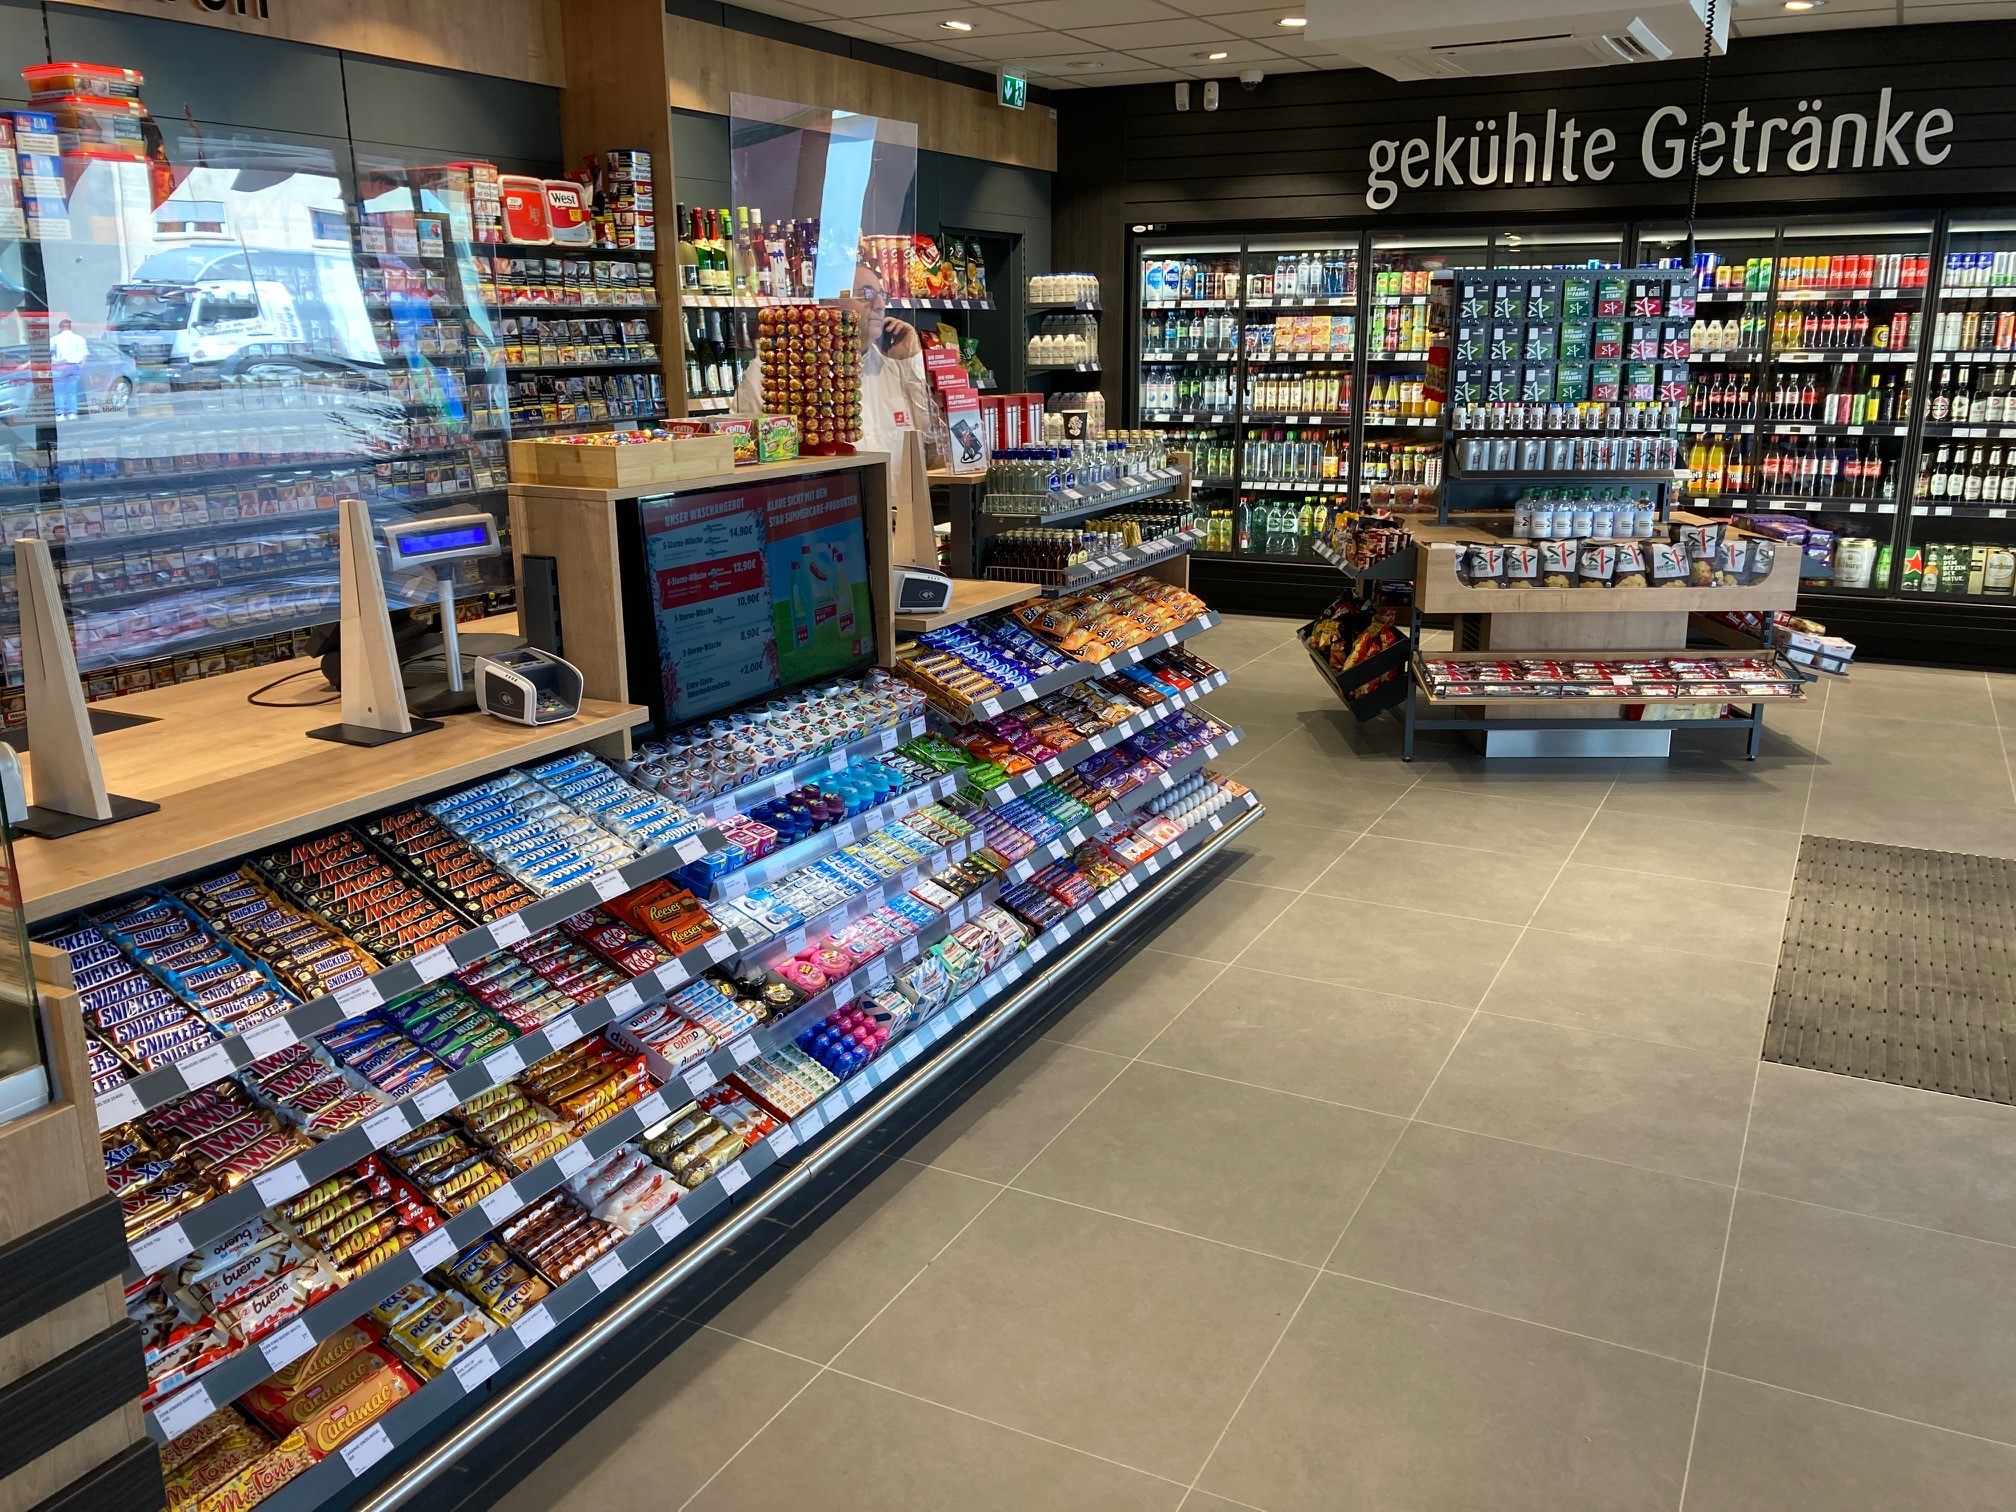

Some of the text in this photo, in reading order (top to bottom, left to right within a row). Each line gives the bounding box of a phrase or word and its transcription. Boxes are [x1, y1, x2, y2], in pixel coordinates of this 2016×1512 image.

[1366, 87, 1954, 210] gekühlte Getränke
[550, 191, 577, 206] West
[725, 424, 747, 434] CENTER
[665, 497, 745, 527] UNSER WASCHANGEBOT
[767, 487, 828, 512] KLARE SICHT MIT DEN
[729, 524, 753, 538] 14,90€
[769, 513, 785, 528] STAR
[733, 559, 757, 573] 12,90€
[737, 592, 760, 607] 10,90€
[565, 772, 607, 794] BOUNTY
[577, 780, 618, 804] BOUNTY
[461, 804, 515, 829] BOUNTY
[475, 813, 527, 838] BOUNTY
[636, 812, 681, 838] BOUNTY
[491, 822, 545, 848] BOUNTY
[508, 831, 560, 855] BOUNTY
[659, 820, 699, 843] BOUNTY
[303, 840, 364, 877] Mars
[436, 851, 479, 879] Mars
[516, 840, 570, 865] BOUNTY
[202, 872, 240, 893] SNICKERS
[334, 863, 395, 901] Mars
[450, 860, 492, 889] Mars
[541, 857, 594, 882] BOUNTY
[229, 899, 267, 923] SNICKERS
[347, 878, 406, 915] Mars
[365, 886, 424, 925] Mars
[481, 883, 524, 911] Mars
[650, 901, 681, 921] Reese's
[136, 918, 189, 945] SNICKERS
[379, 899, 436, 937] Mars
[398, 909, 455, 949] Mars
[568, 909, 595, 933] KitKat
[154, 932, 208, 961] SNICKERS
[599, 926, 627, 950] KitKat
[671, 924, 702, 943] Reese's
[188, 962, 240, 987] SNICKERS
[315, 951, 352, 973] SNICKERS
[628, 948, 656, 972] KitKat
[201, 972, 254, 1003] SNICKERS
[327, 965, 364, 990] SNICKERS
[81, 973, 151, 1013] SNICKERS
[213, 990, 267, 1019] SNICKERS
[100, 988, 175, 1028] SNICKERS
[135, 1018, 206, 1059] SNICKERS
[611, 1030, 640, 1058] dupl
[358, 1045, 400, 1075] Knoppers
[259, 1057, 325, 1099] TWIX
[393, 1073, 427, 1101] noppers
[289, 1077, 349, 1111] TWIX
[468, 1082, 510, 1112] LION
[309, 1093, 373, 1131] TWIX
[485, 1097, 524, 1128] LION
[499, 1107, 539, 1140] LION
[186, 1113, 273, 1163] TWIX
[511, 1120, 551, 1151] LION
[211, 1133, 299, 1179] TWIX
[415, 1135, 456, 1168] LION
[446, 1162, 486, 1195] LION
[293, 1179, 339, 1218] LION
[305, 1194, 351, 1237] LION
[328, 1204, 373, 1246] LION
[213, 1228, 252, 1256] bueno
[334, 1222, 380, 1264] LION
[355, 1235, 400, 1277] LION
[222, 1256, 261, 1286] bueno
[252, 1283, 290, 1314] bueno
[316, 1382, 394, 1452] Caramac
